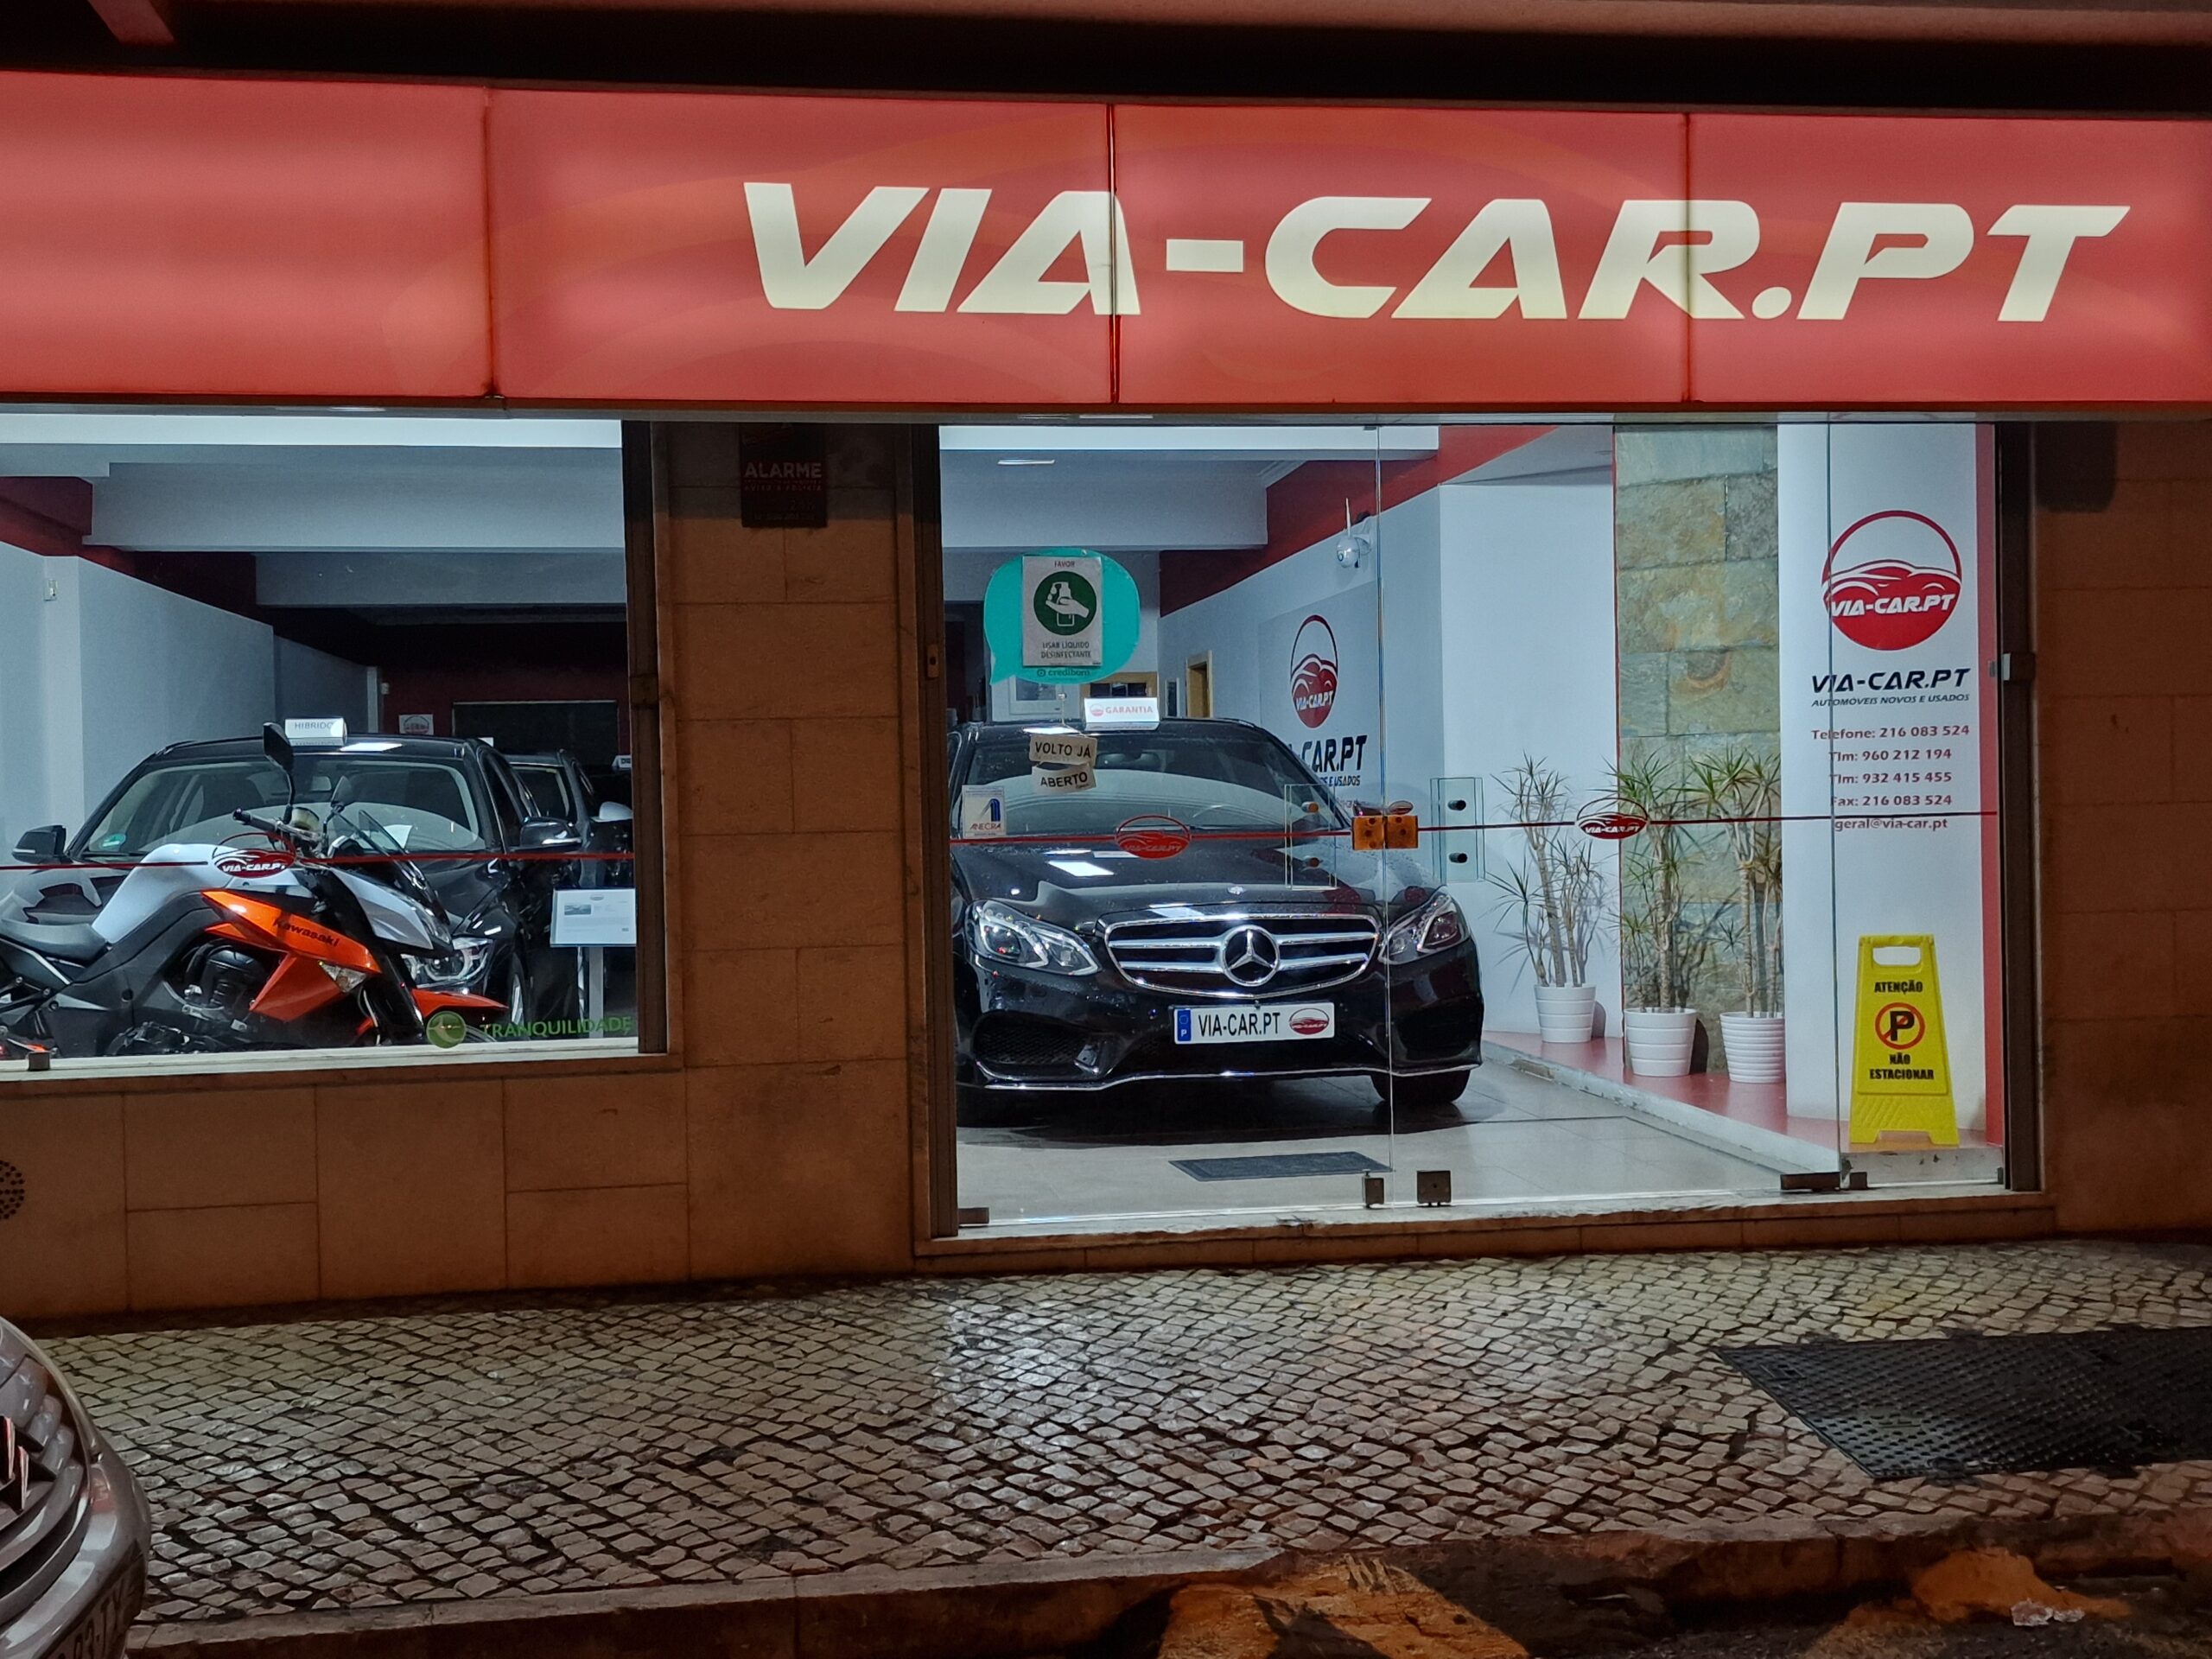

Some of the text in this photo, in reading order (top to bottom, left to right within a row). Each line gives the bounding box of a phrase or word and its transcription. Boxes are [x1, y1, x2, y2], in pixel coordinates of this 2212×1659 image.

[743, 181, 2131, 323] VIA-CAR.PT
[744, 462, 822, 479] ALARME
[1832, 594, 1955, 616] VIA-CAR.PT
[1812, 668, 1971, 693] VIA-CAR.PT
[1879, 696, 1916, 704] NOVOS
[1928, 693, 1970, 702] USADOS
[1811, 724, 1970, 740] Telefone: 216 083 524
[1035, 741, 1091, 759] VOLTO JÁ
[1862, 750, 1889, 761] 960
[1892, 749, 1920, 760] 212
[1926, 748, 1952, 760] 194
[1040, 772, 1088, 787] ABERTO
[1862, 772, 1889, 784] 932
[1892, 772, 1920, 783] 415
[1924, 772, 1953, 782] 455
[1862, 796, 1889, 806] 216
[1893, 794, 1920, 805] 083
[1925, 794, 1953, 804] 524
[1834, 817, 1948, 832] geral@via-car.pt
[272, 918, 340, 947] Kawasaki
[1874, 980, 1923, 995] ATENÇÃO
[480, 1016, 632, 1038] TRANQUILIDADE
[1198, 1013, 1281, 1037] VIA-CAR.PT
[1890, 1052, 1910, 1065] NÃO
[1870, 1069, 1934, 1079] ESTACIONAR
